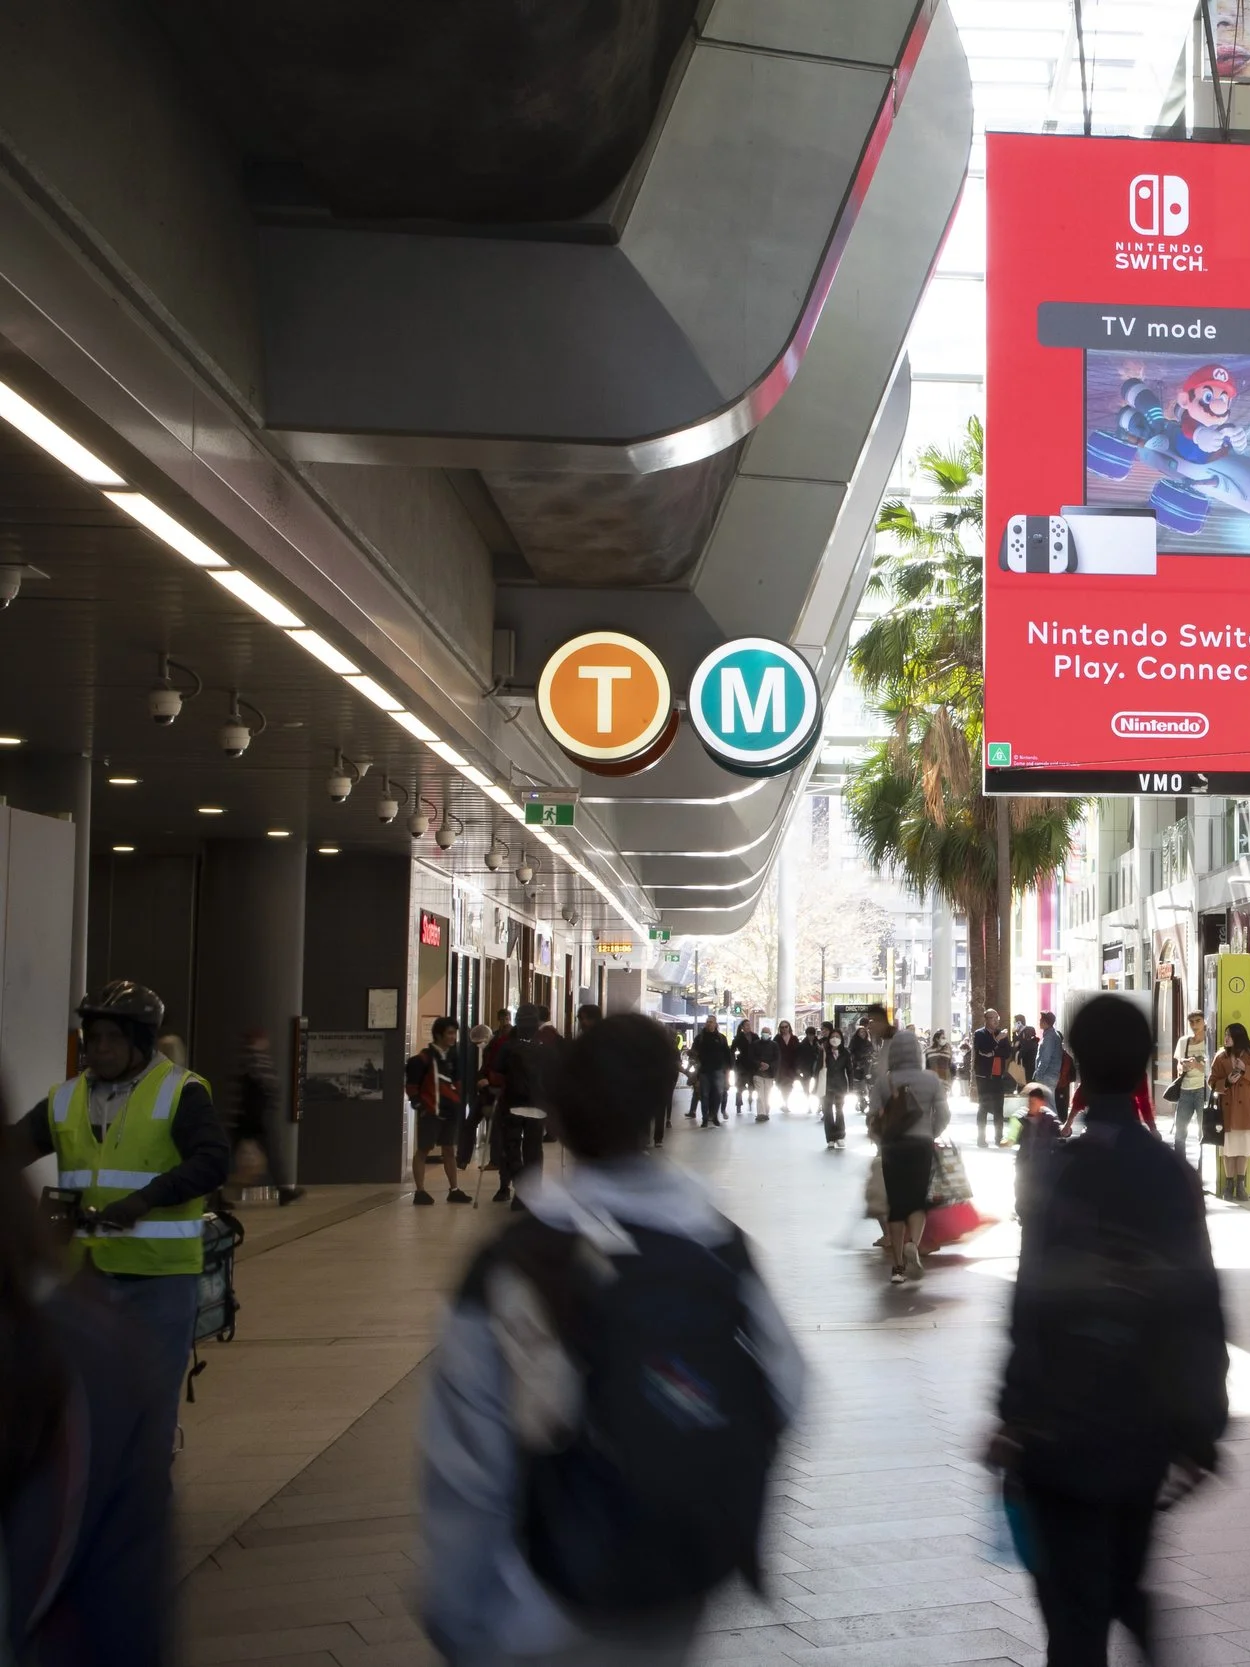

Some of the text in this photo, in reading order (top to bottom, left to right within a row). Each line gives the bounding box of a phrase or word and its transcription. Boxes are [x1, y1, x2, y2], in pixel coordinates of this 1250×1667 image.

[1115, 241, 1203, 254] NINTENDO
[1101, 316, 1217, 339] TV mode
[1028, 621, 1168, 647] Nintendo
[1054, 654, 1125, 684] Play.
[578, 666, 631, 733] T
[721, 668, 785, 733] M
[1119, 717, 1203, 734] Nintendo
[1139, 773, 1183, 793] VMO
